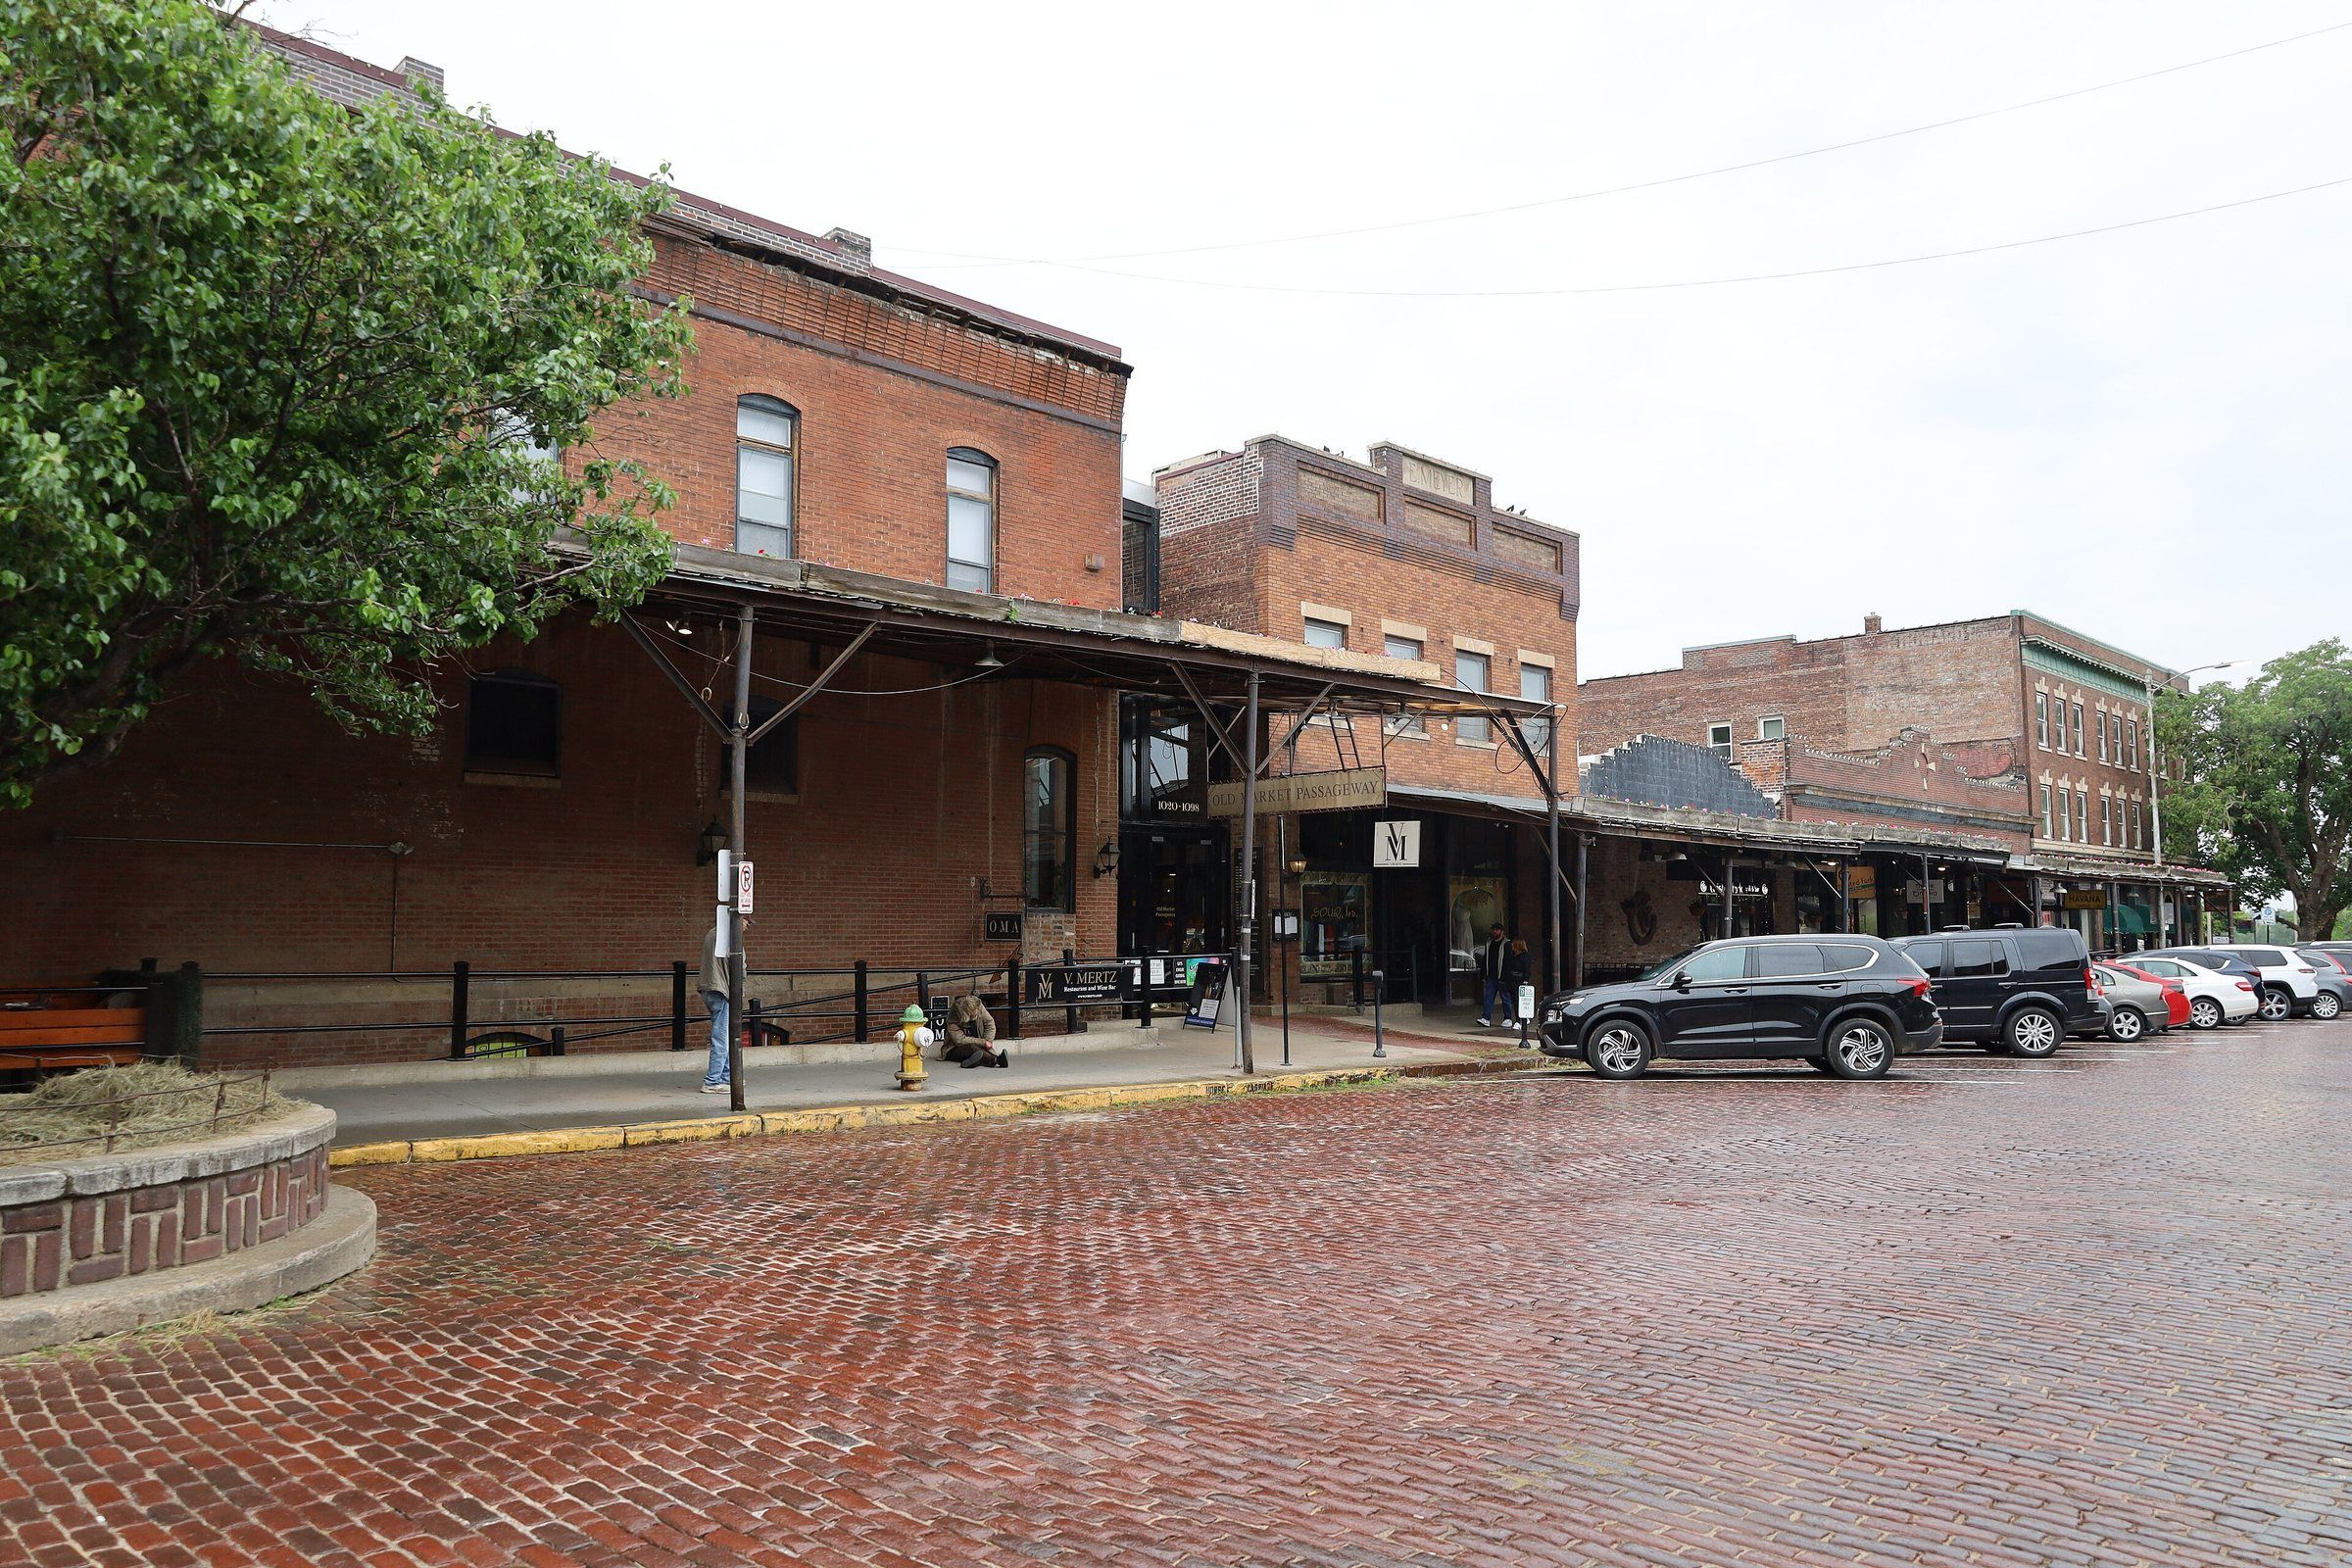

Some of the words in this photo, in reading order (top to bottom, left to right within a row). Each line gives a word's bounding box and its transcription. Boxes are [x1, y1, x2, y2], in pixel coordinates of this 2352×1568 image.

[1212, 793, 1236, 808] OLD
[1297, 781, 1378, 800] PASSAGEWAY
[989, 920, 1019, 933] OMA
[1064, 972, 1073, 984] V.
[1077, 970, 1117, 984] MERTZ
